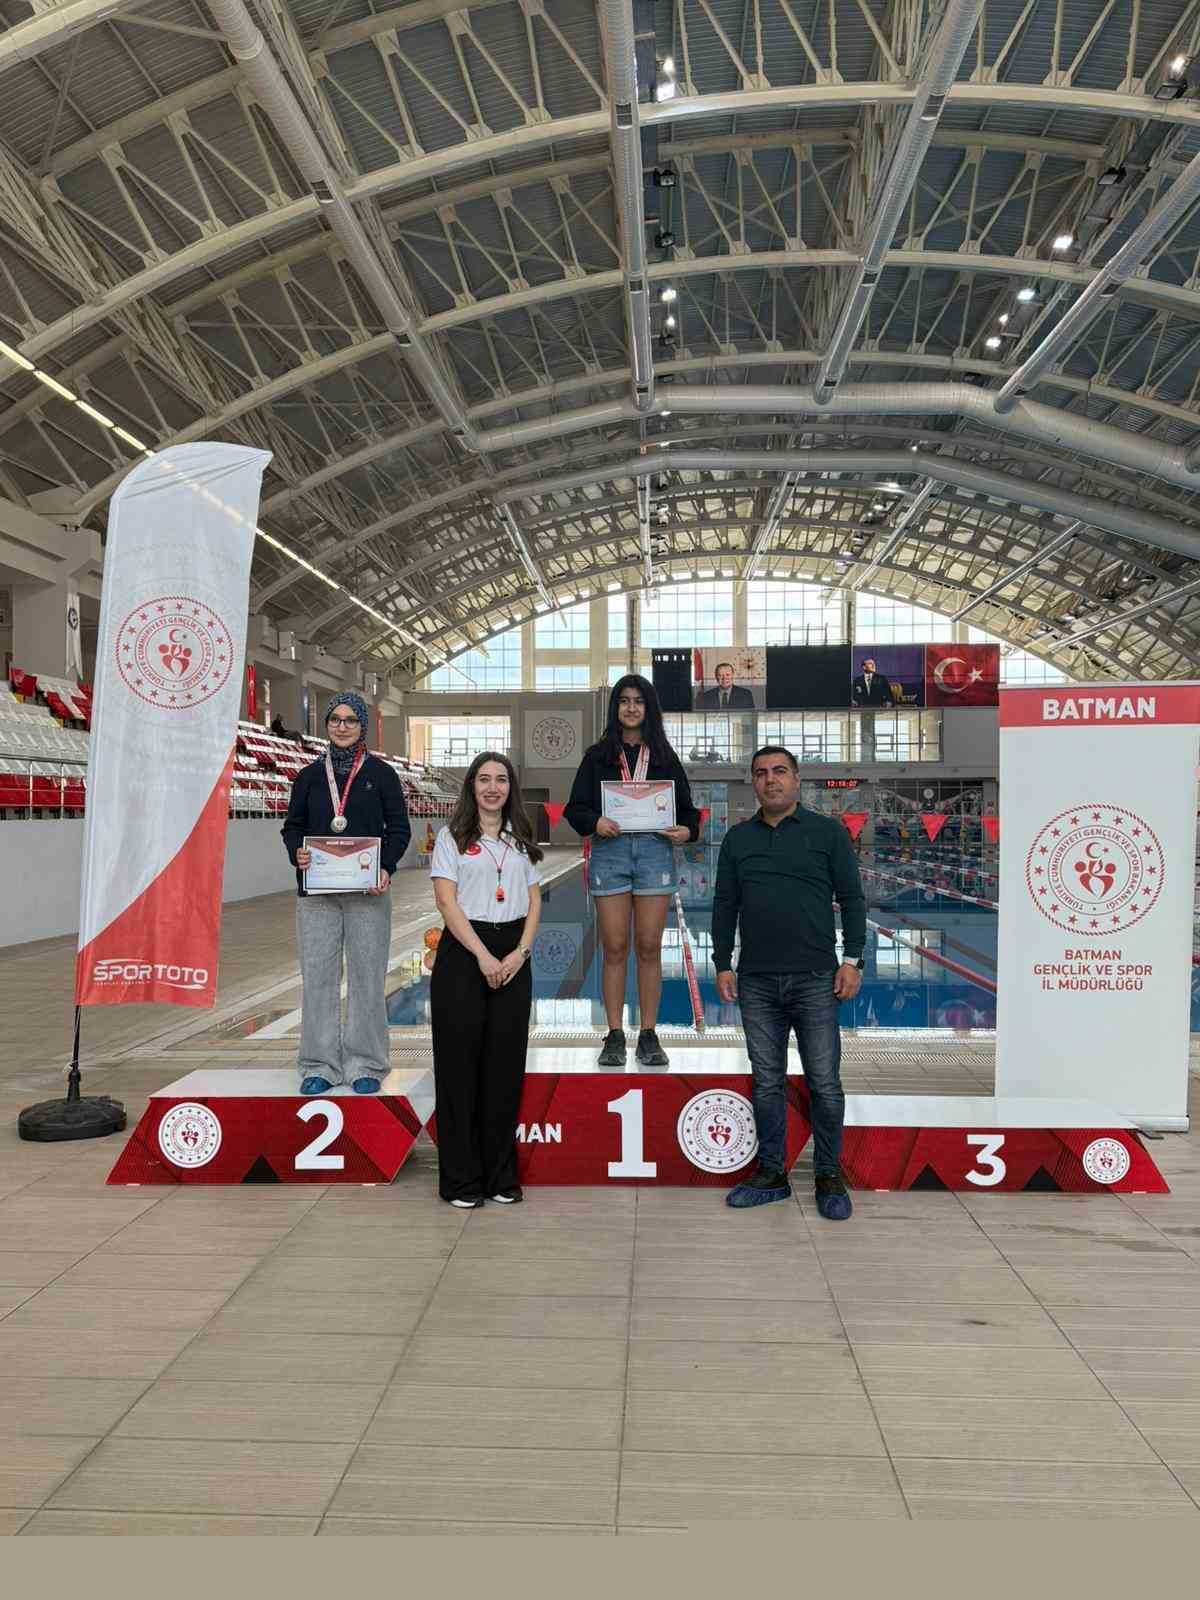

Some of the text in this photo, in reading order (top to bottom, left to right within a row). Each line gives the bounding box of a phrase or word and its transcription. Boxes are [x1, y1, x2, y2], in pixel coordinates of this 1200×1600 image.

[1043, 697, 1156, 720] BATMAN
[1065, 950, 1121, 960] BATMAN
[1034, 962, 1152, 977] GENÇLİK VE SPOR
[1042, 977, 1143, 991] İL MÜDÜRLÜĞÜ
[295, 1100, 344, 1170] 2
[515, 1123, 562, 1143] MAN
[608, 1089, 656, 1177] 1
[965, 1135, 1007, 1186] 3
